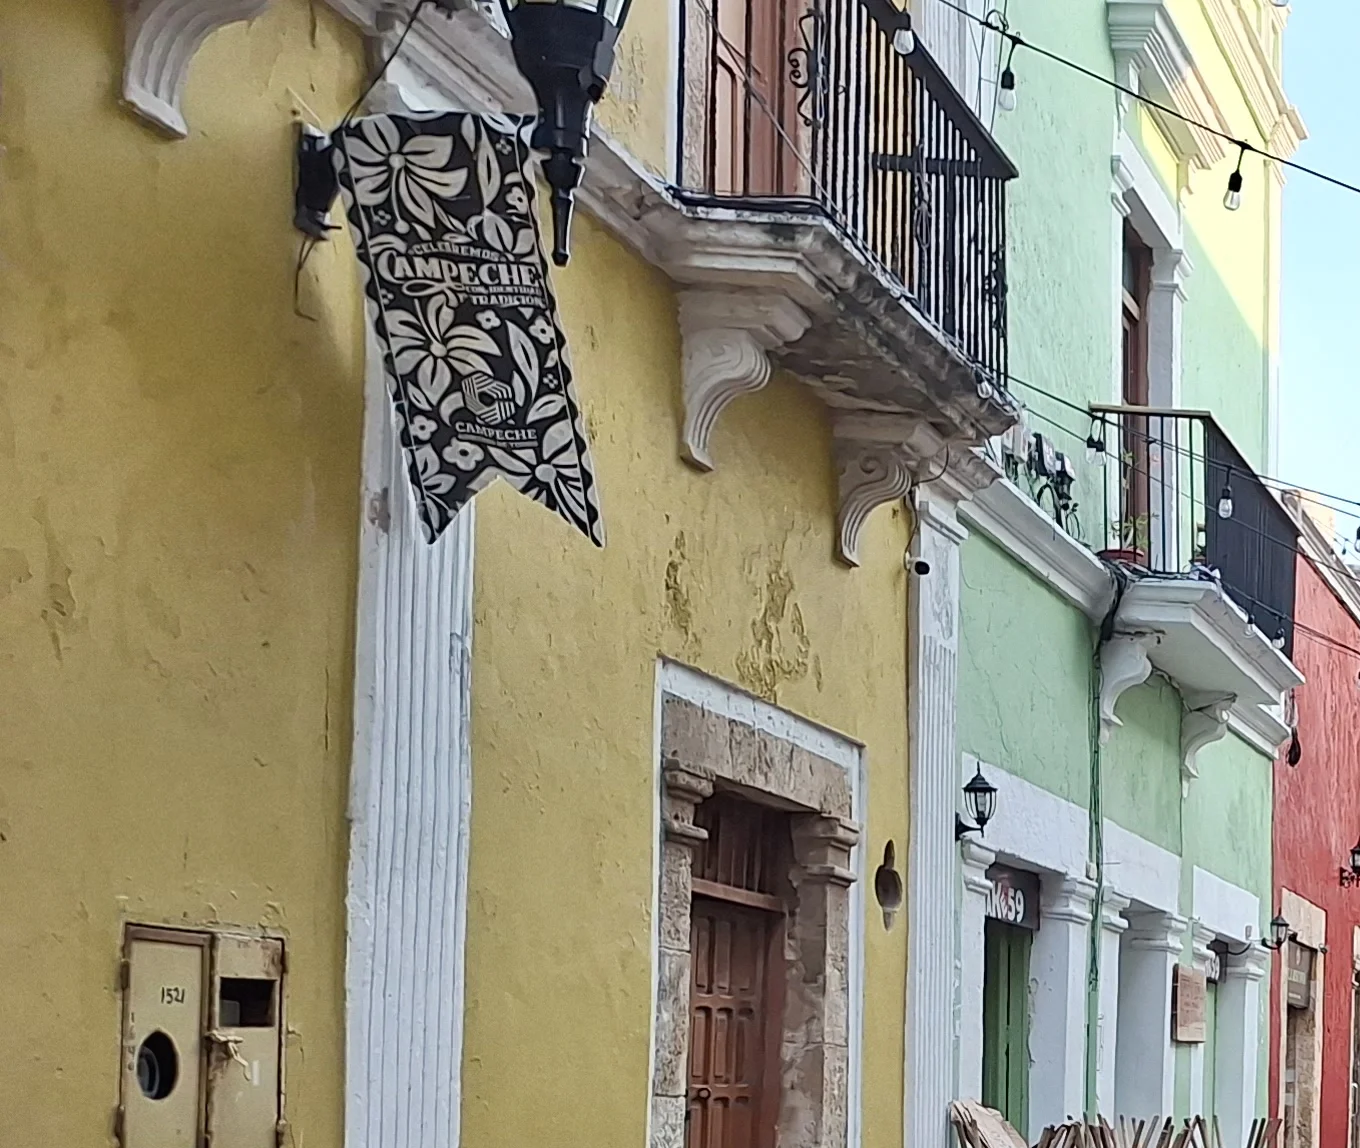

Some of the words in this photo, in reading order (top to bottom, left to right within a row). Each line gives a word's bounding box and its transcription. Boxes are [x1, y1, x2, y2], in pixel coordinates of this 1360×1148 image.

[377, 250, 540, 290] CAMPECHE
[455, 421, 538, 441] CAMPECHE
[160, 986, 185, 1005] 1521
